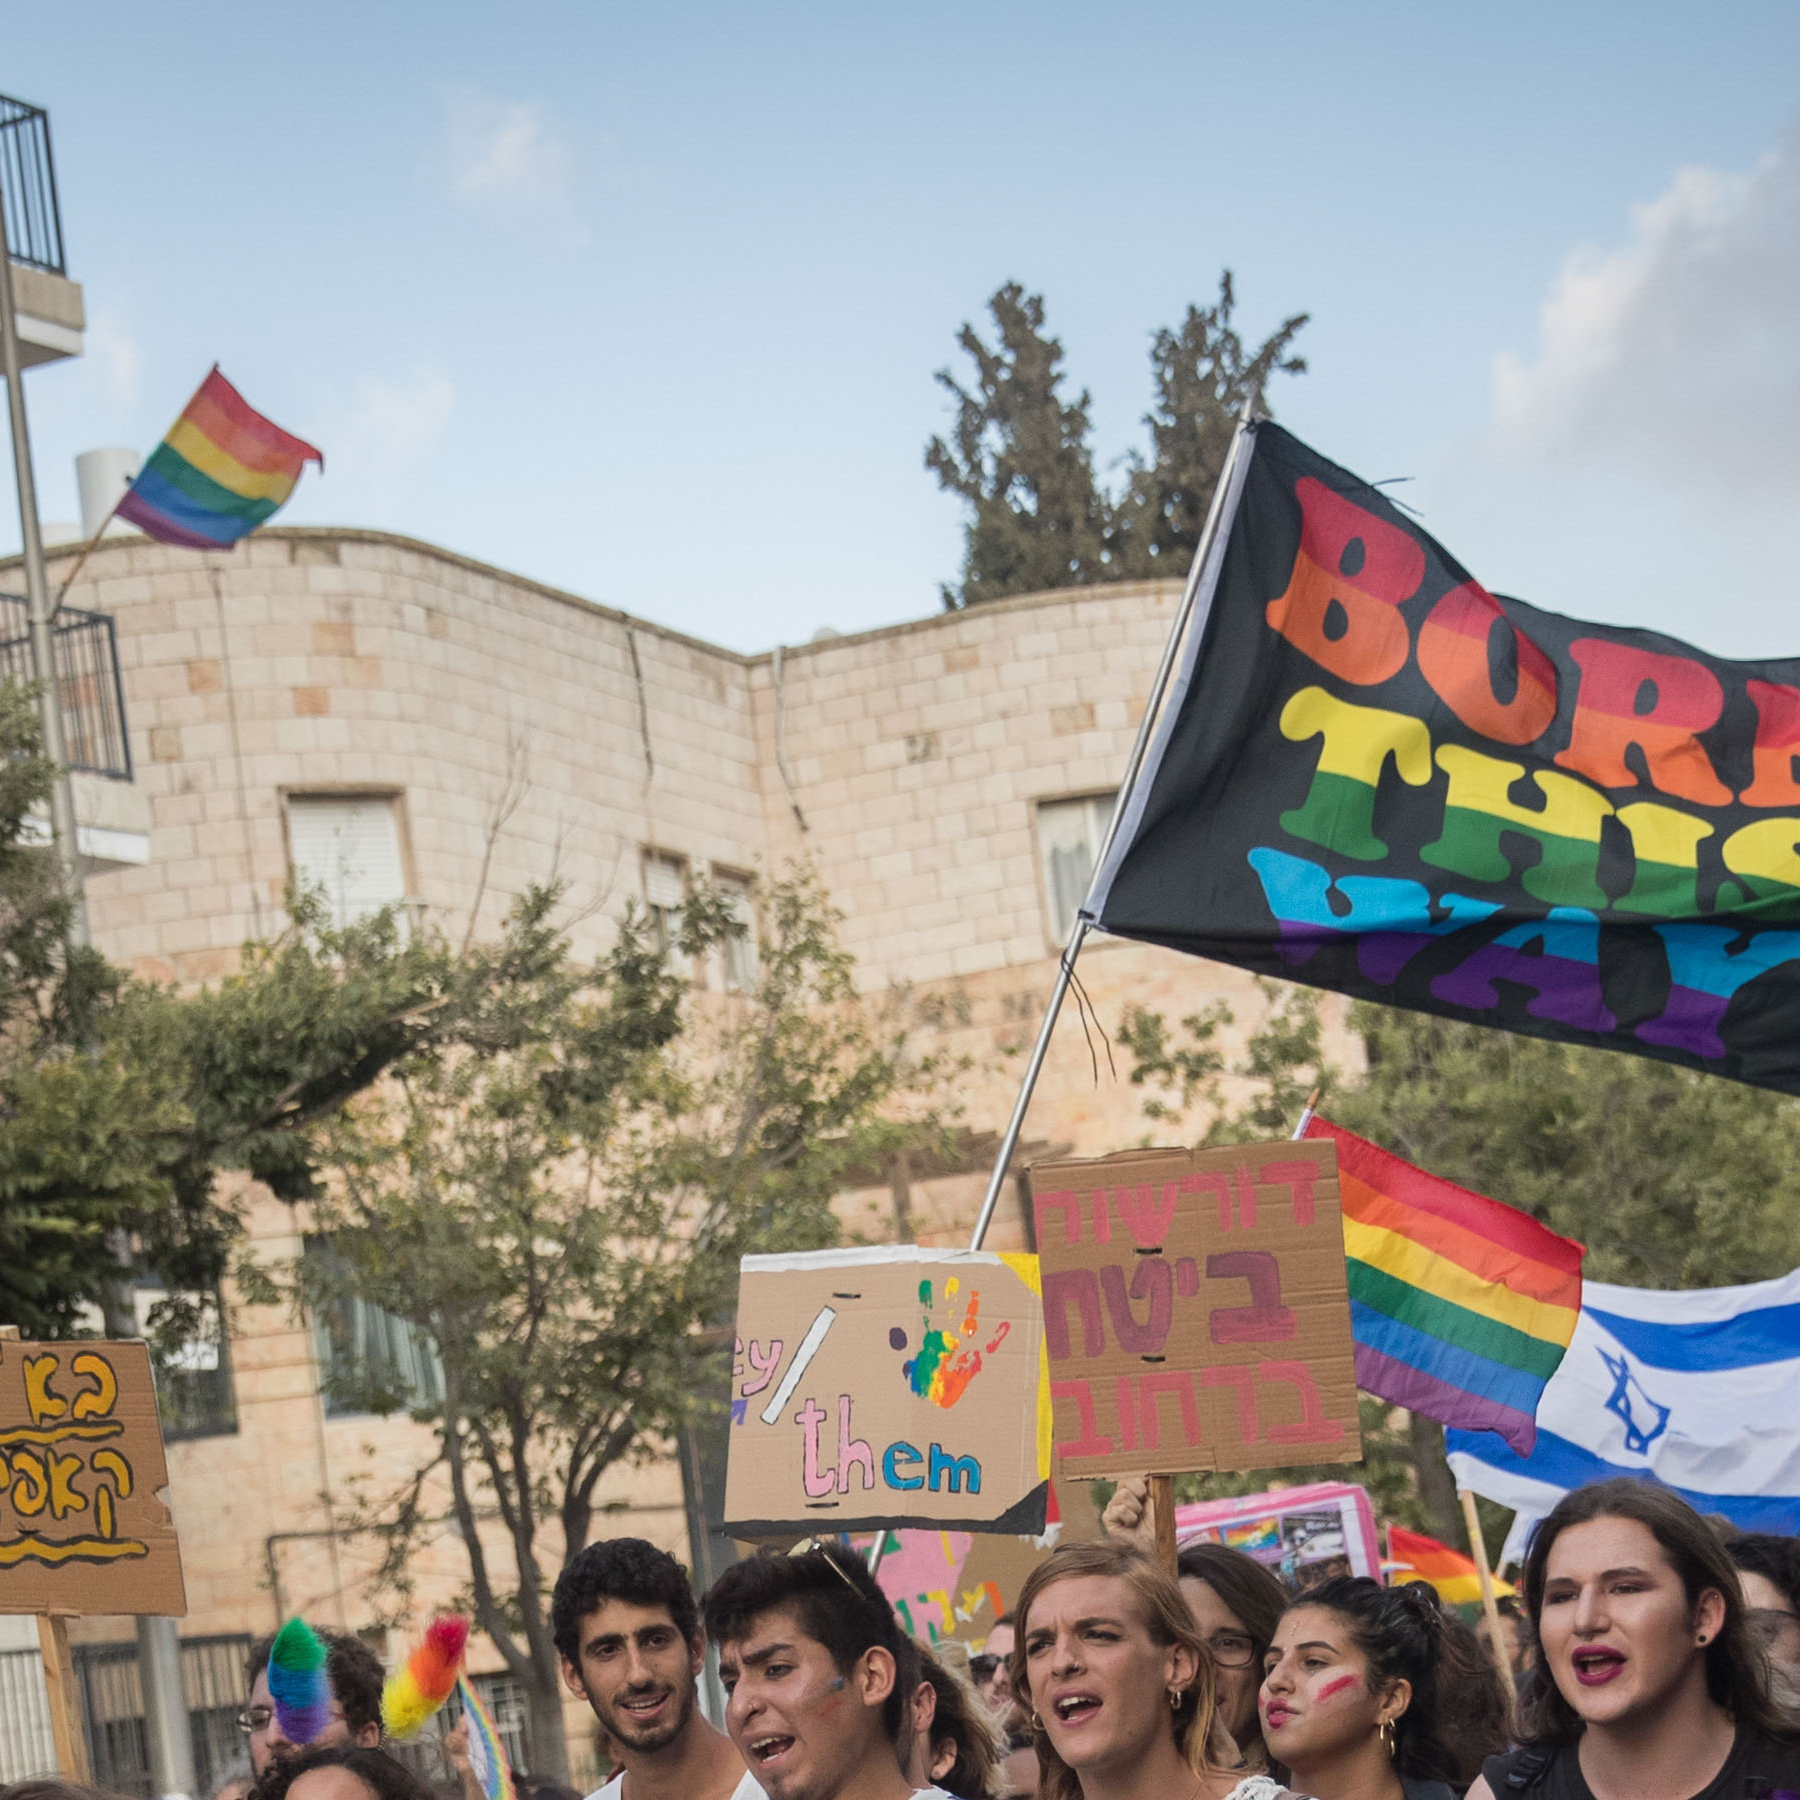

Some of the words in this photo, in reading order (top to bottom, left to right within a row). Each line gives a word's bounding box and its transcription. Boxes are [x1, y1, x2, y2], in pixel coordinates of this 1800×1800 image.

[1031, 1159, 1320, 1250] דורשות
[795, 1394, 981, 1499] them
[1050, 1359, 1344, 1458] ברחוב
